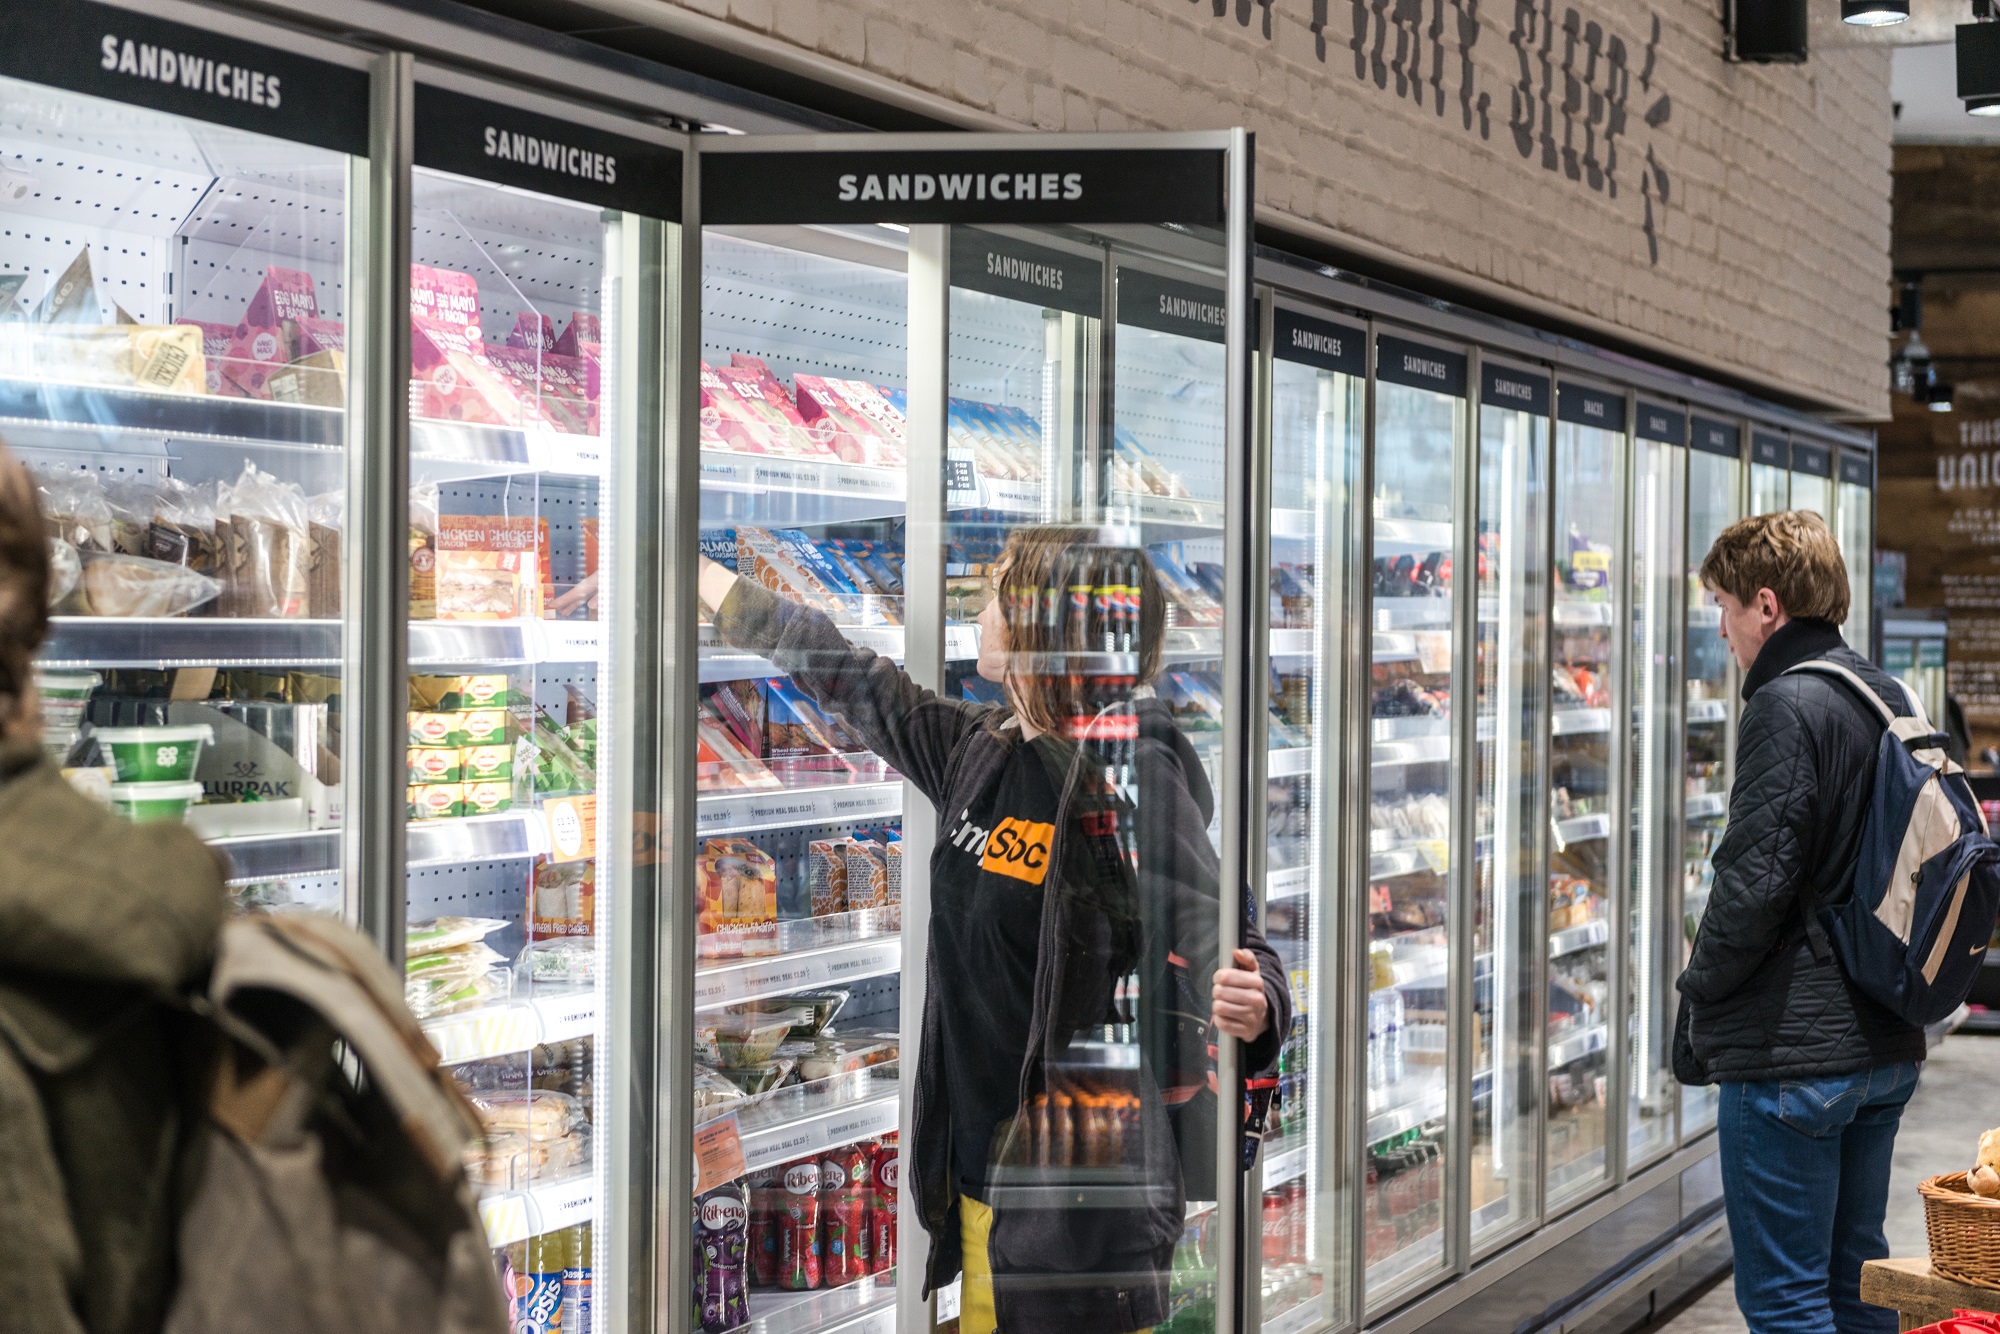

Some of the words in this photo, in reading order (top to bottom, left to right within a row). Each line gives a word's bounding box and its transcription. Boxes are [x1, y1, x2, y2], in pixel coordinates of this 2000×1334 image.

[101, 34, 282, 109] SANDWICHES
[484, 126, 617, 184] SANDWICHES
[838, 173, 1083, 201] SANDWICHES
[986, 252, 1064, 291] SANDWICHES
[274, 290, 290, 305] EGG
[291, 292, 315, 310] MAYO
[436, 292, 449, 308] EGG
[450, 294, 476, 312] MAYO
[445, 309, 469, 326] BACON
[1159, 294, 1226, 327] SANDWICHES
[1292, 328, 1342, 357] SANDWICHES
[1403, 354, 1446, 380] SANDWICHES
[731, 382, 765, 400] BLT
[808, 389, 836, 407] BLT
[1494, 378, 1532, 401] SANDWICHES
[438, 528, 485, 543] HICKEN
[489, 528, 544, 544] CHICKEN
[699, 541, 737, 552] ALMON
[204, 781, 291, 796] LURPAK
[755, 808, 775, 816] PREMIUM
[775, 807, 787, 815] MEAL
[788, 806, 799, 814] DEAL
[837, 801, 855, 809] PREMIUM
[552, 922, 568, 933] FRIED
[568, 923, 590, 935] CHICKEN
[716, 923, 750, 935] CHICKEN
[750, 920, 776, 933] FAJITA
[831, 963, 850, 972] PREMIUM
[850, 960, 861, 968] MEAL
[750, 979, 769, 987] PREMIUM
[770, 976, 782, 984] MEAL
[782, 974, 793, 982] DEAL
[831, 1126, 849, 1135] PREMIUM
[849, 1122, 860, 1130] MEAL
[770, 1145, 781, 1153] MEAL
[781, 1142, 793, 1150] DEAL
[825, 1168, 844, 1180] ena
[703, 1204, 745, 1222] Ribena
[562, 1268, 584, 1280] Oasis
[709, 1261, 738, 1270] blackcurrant
[516, 1277, 562, 1334] Oasis
